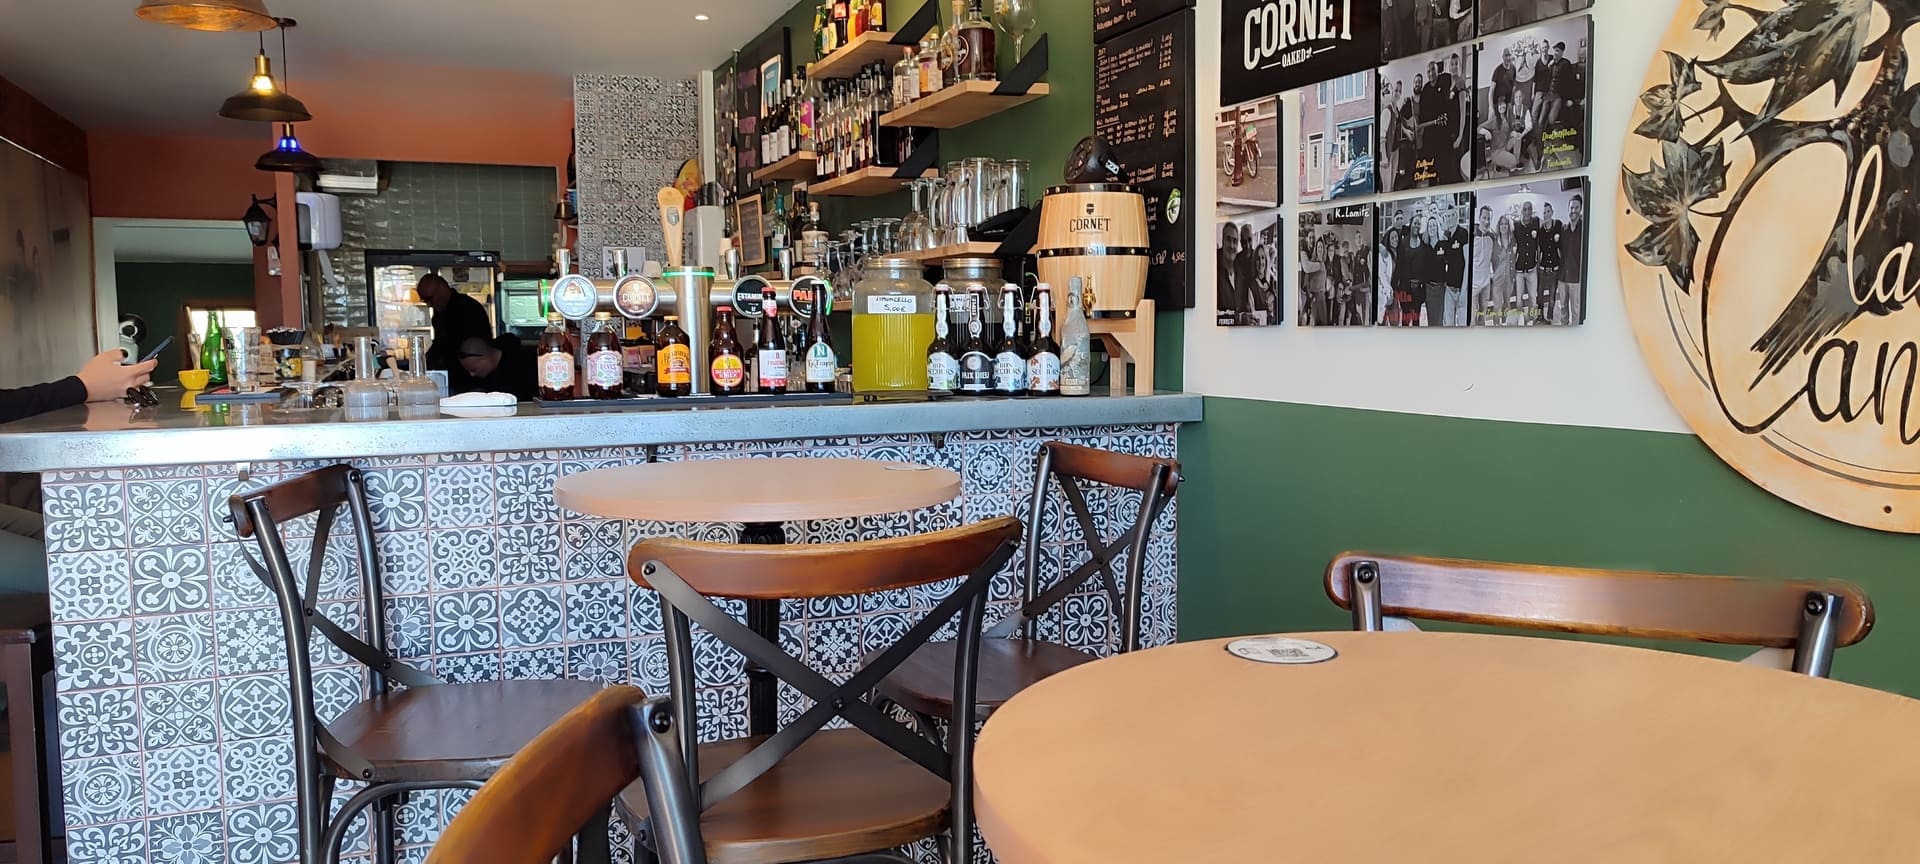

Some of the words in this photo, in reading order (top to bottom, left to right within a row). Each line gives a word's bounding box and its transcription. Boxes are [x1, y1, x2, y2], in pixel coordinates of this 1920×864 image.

[1244, 0, 1352, 70] CORNET
[1281, 48, 1307, 68] OAKED
[1069, 218, 1111, 233] CORNET
[875, 296, 912, 304] LIMONCELLO
[884, 304, 906, 313] 5,00€
